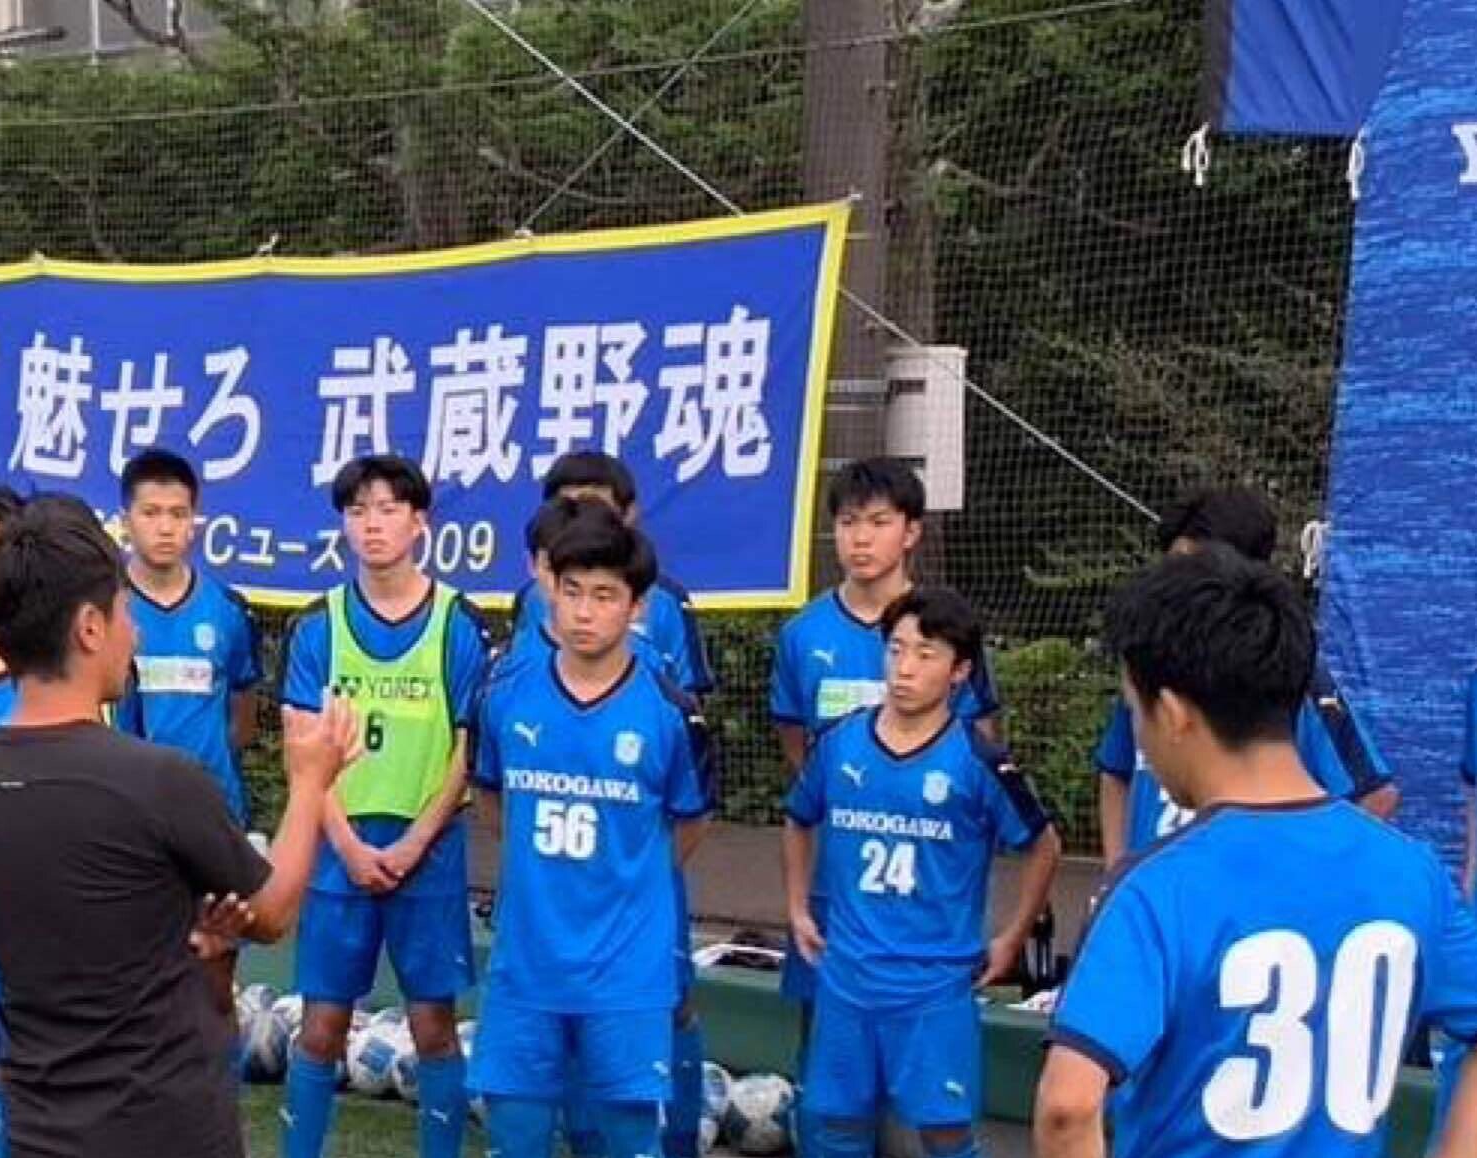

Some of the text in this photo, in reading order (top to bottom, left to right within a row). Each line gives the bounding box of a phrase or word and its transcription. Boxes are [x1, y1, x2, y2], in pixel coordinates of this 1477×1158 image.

[8, 304, 772, 490] 魅せろ 武蔵野魂
[365, 709, 384, 753] 6
[506, 768, 640, 804] YOKOGAWA
[532, 799, 599, 860] 56
[859, 839, 916, 896] 24
[1201, 919, 1417, 1140] 30
